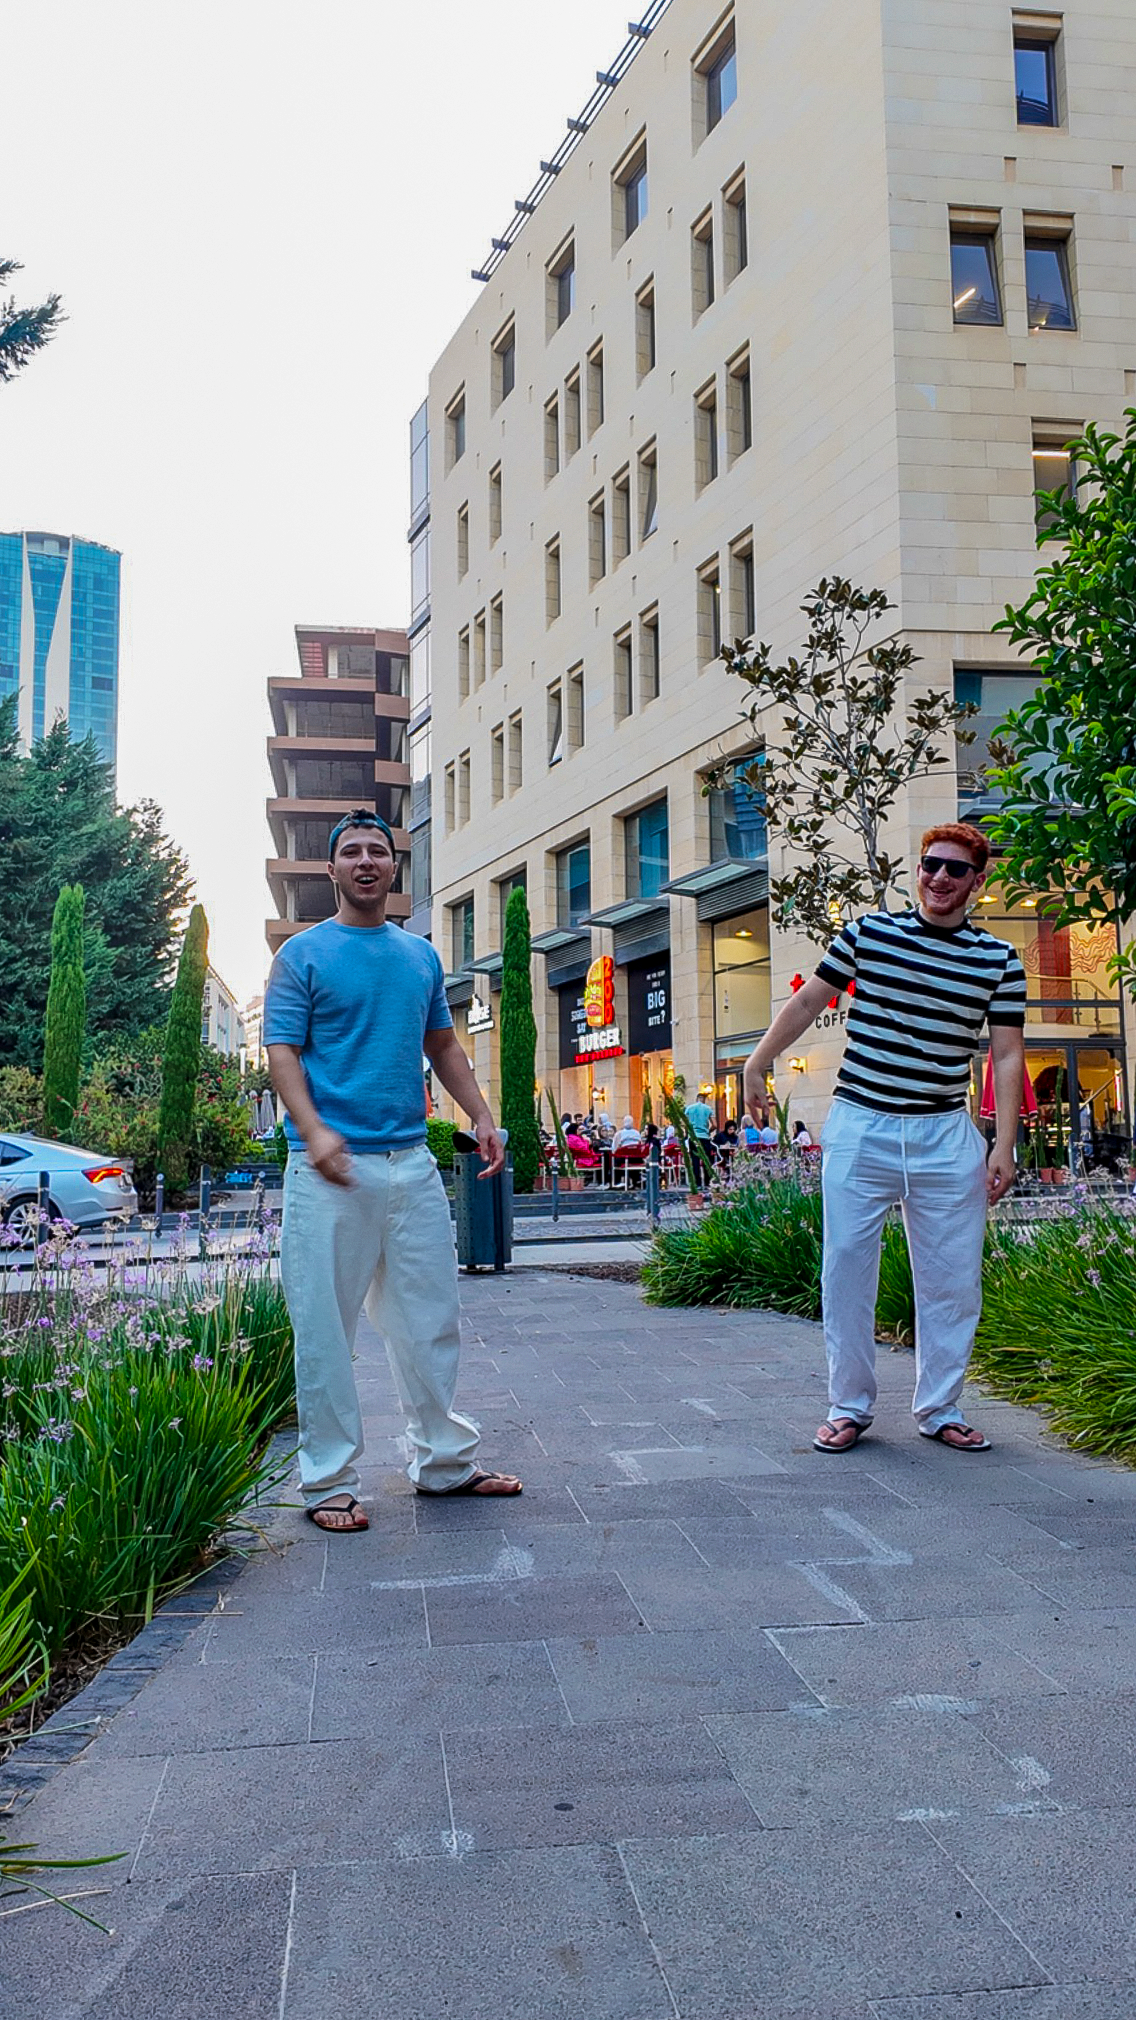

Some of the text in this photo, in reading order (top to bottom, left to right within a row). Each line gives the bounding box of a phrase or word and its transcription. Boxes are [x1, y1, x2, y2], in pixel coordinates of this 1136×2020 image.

[647, 989, 666, 1010] BIG
[648, 1009, 666, 1027] BITE?
[815, 1010, 847, 1029] COFF
[579, 1027, 620, 1053] BURGER
